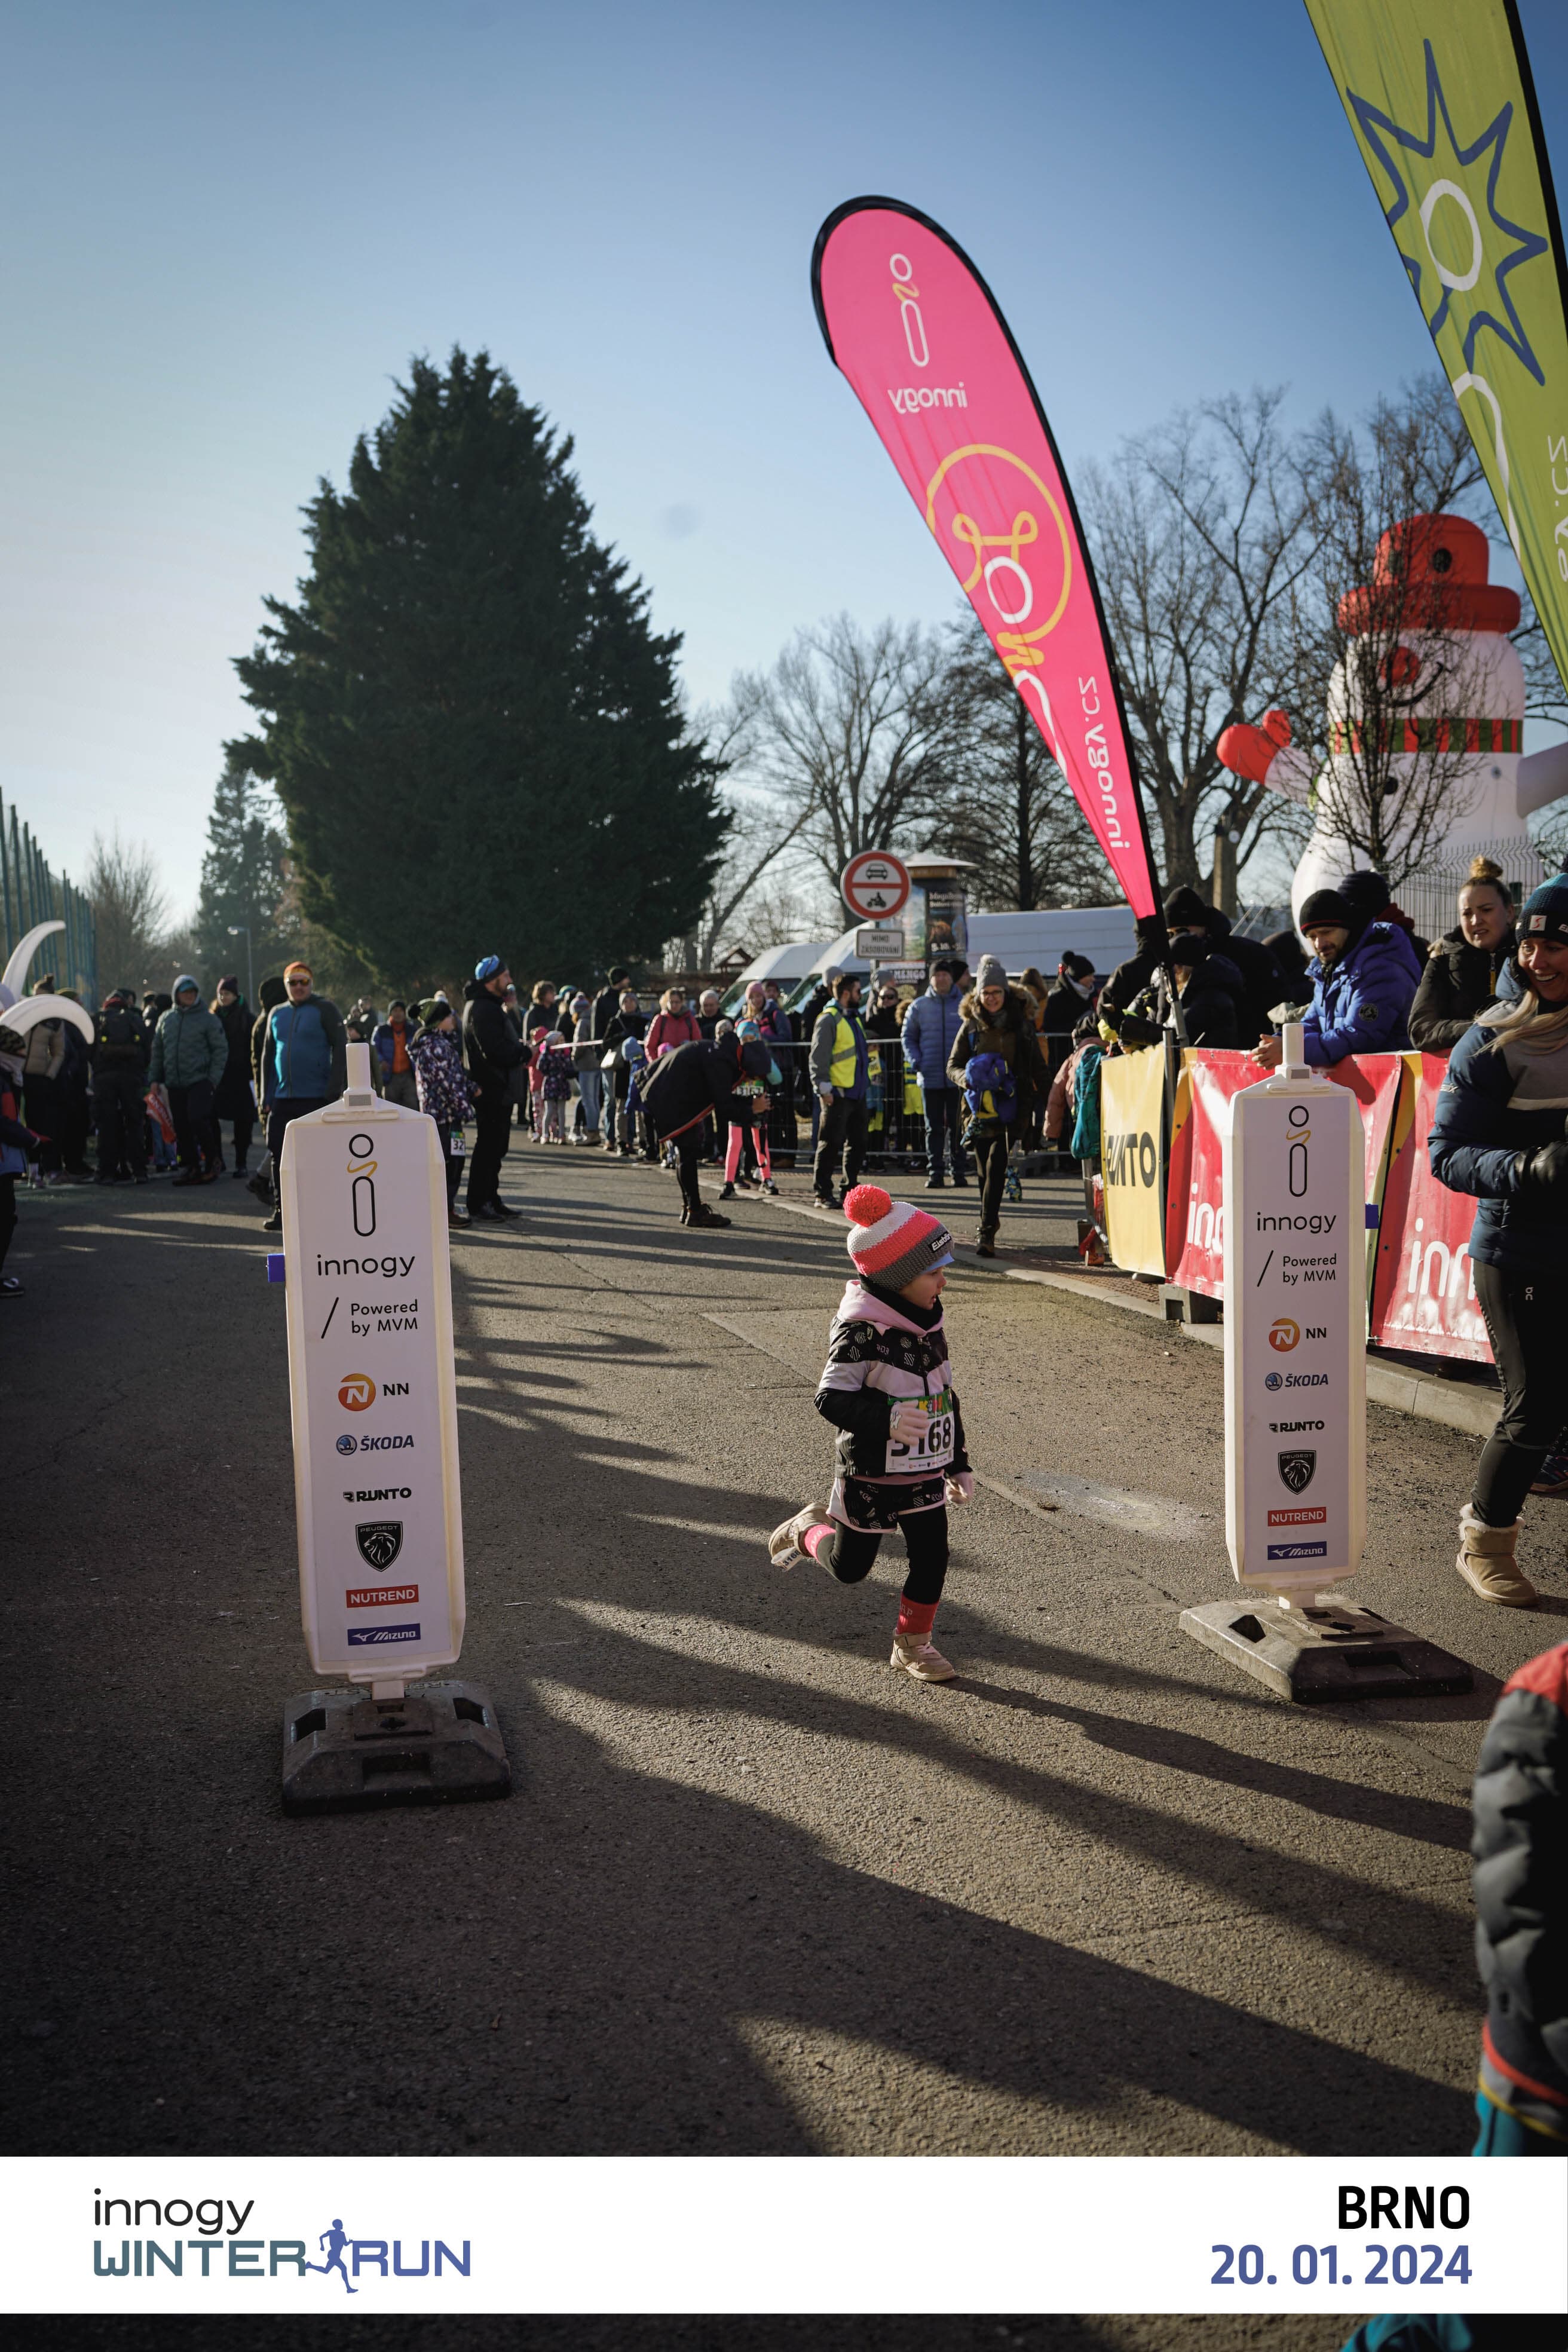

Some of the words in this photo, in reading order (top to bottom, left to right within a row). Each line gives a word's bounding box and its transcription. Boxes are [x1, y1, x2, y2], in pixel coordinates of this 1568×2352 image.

[1257, 1211, 1337, 1234] innogy
[317, 1253, 415, 1278] innogy
[1282, 1252, 1337, 1267] Powered
[1282, 1271, 1298, 1286] by
[1304, 1269, 1336, 1282] MVM
[351, 1298, 418, 1316] Powered
[351, 1320, 370, 1337] by
[378, 1317, 418, 1332] MVM
[1306, 1327, 1327, 1339] NN
[1285, 1373, 1329, 1388] ŠKODA
[382, 1382, 409, 1396] NN
[1280, 1420, 1325, 1433] RUNTO
[360, 1435, 415, 1451] ŠKODA
[356, 1487, 412, 1502] RUNTO
[1271, 1511, 1324, 1523] NUTREND
[360, 1524, 399, 1533] PEUGEOT
[350, 1589, 416, 1604] NUTREND
